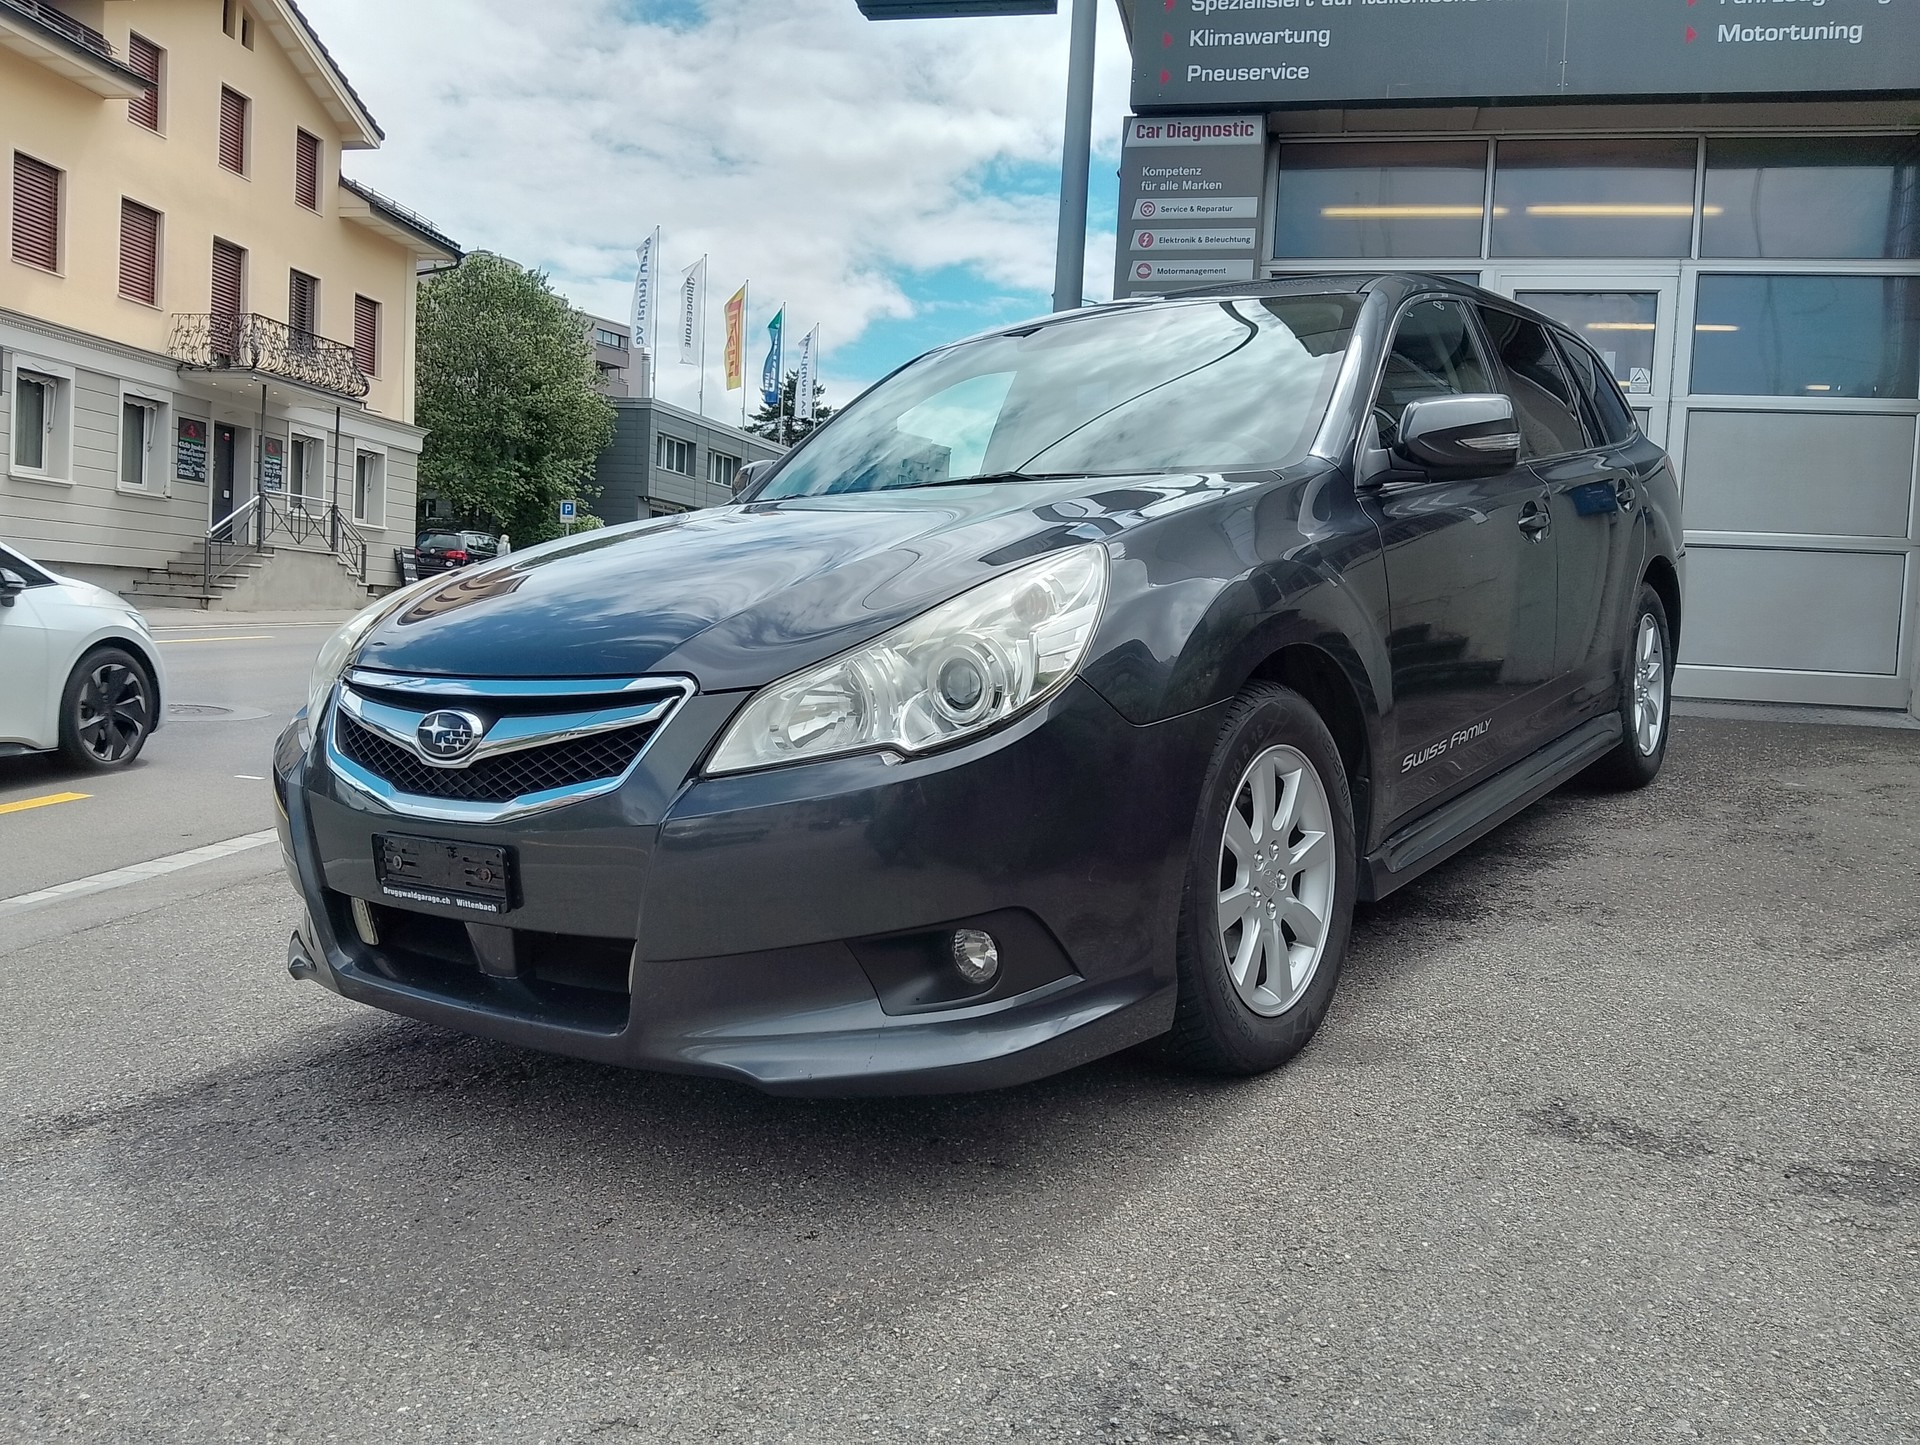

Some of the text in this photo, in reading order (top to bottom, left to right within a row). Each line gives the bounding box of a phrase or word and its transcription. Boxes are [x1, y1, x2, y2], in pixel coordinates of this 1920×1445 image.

[1189, 28, 1331, 47] Klimawartung
[1717, 20, 1864, 44] Motortuning
[1187, 62, 1310, 82] Pneuservice
[1136, 121, 1255, 142] Car Diagnostic
[1142, 166, 1202, 178] Kompetenz
[1141, 180, 1222, 191] für alle Marken
[1196, 205, 1233, 214] Reparatur
[1159, 235, 1251, 245] Elektronik & Beleuchtung
[1157, 267, 1227, 276] Motormanagement
[637, 279, 648, 321] KRÜSI
[636, 326, 644, 345] AG
[565, 504, 572, 514] P
[1401, 718, 1492, 773] SWISS FAMILY
[383, 886, 497, 912] Bruggwaldgarage.ch Wittenbach
